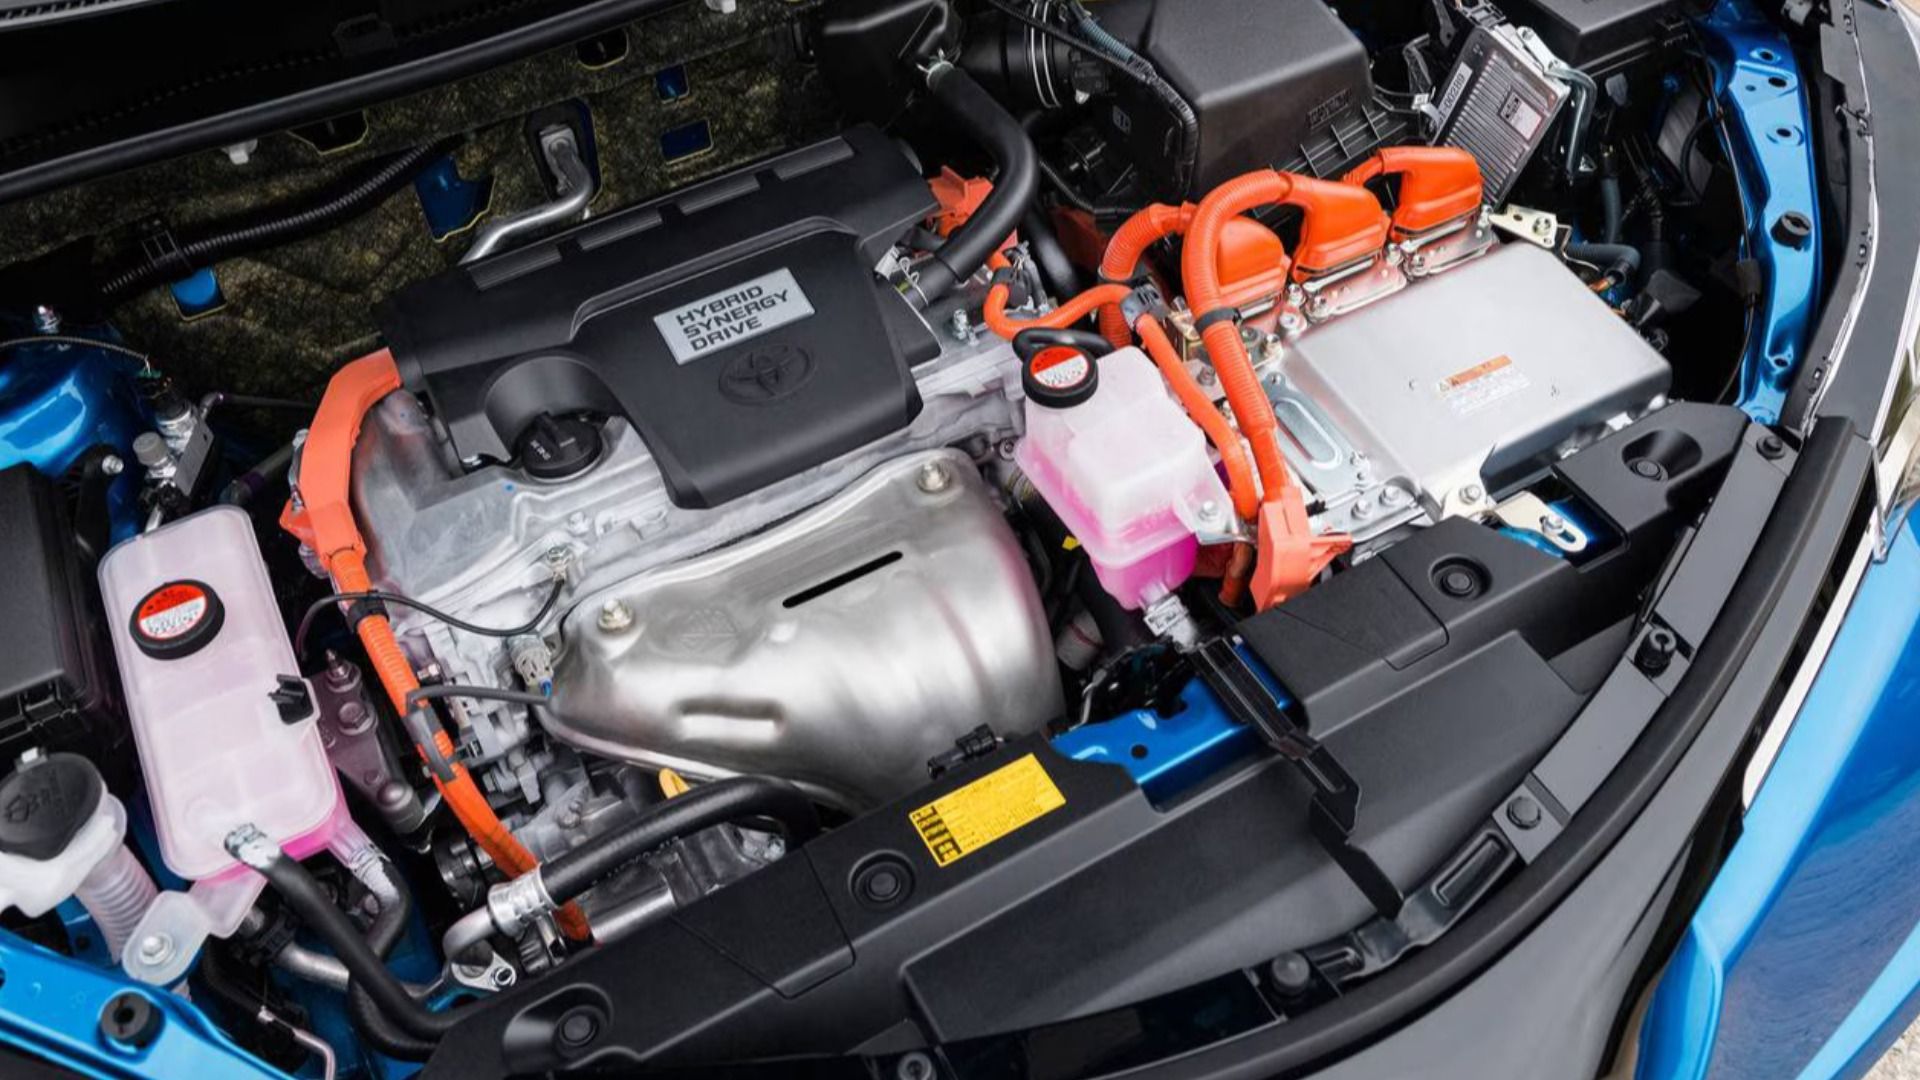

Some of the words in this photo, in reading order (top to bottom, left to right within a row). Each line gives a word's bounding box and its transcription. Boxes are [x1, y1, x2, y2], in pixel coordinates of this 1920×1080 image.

[675, 285, 764, 326] HYBRID
[683, 289, 789, 339] SYNERGY
[690, 316, 763, 352] DRIVE
